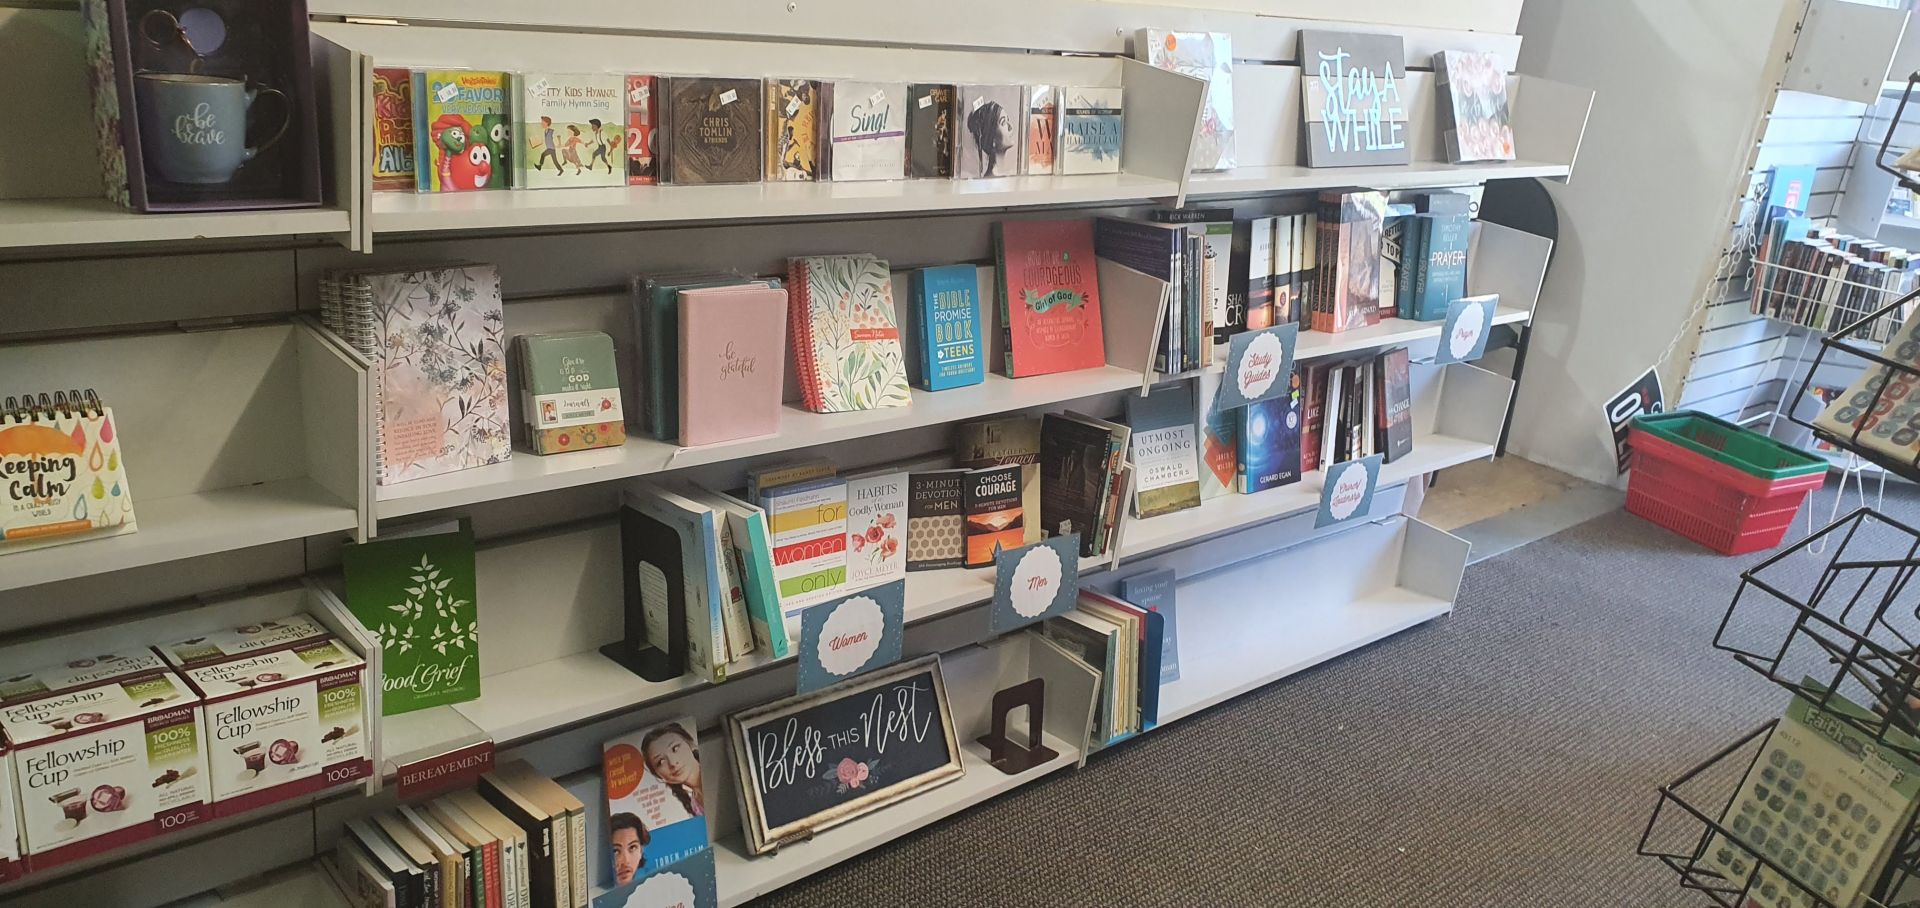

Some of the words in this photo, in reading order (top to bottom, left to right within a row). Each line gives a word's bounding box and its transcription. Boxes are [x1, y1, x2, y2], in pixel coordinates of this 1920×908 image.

[541, 99, 567, 109] Family
[568, 100, 592, 110] Hymn
[593, 101, 610, 110] Sing
[187, 103, 216, 128] be
[703, 117, 729, 127] CHRIS
[171, 114, 225, 145] brave
[700, 128, 732, 137] TOMLIN
[1068, 122, 1106, 136] RAISE
[1112, 122, 1119, 135] A
[1321, 108, 1405, 152] WHILE
[1431, 250, 1464, 267] PRAYER
[1024, 264, 1081, 288] COURAGEOUS
[939, 289, 971, 309] BIBLE
[1048, 294, 1056, 304] of
[1057, 291, 1072, 301] God
[934, 308, 972, 322] PROMISE
[936, 320, 973, 343] BOOK
[719, 341, 736, 360] be
[944, 344, 974, 359] TEENS
[720, 357, 756, 380] grateful
[568, 374, 589, 383] GOD
[1140, 429, 1185, 445] UTMOST
[1138, 440, 1191, 457] ONGOING
[1144, 470, 1190, 483] CHAMBERS
[1149, 463, 1183, 475] OSWALD
[1260, 474, 1278, 483] GERARD
[1279, 471, 1292, 480] EGAN
[9, 474, 71, 500] Calm
[980, 473, 1012, 484] CHOOSE
[857, 484, 898, 500] HABITS
[975, 480, 1017, 497] COURAGE
[817, 504, 842, 524] for
[849, 505, 874, 517] Godly
[874, 501, 904, 512] Woman
[934, 501, 958, 511] MEN
[775, 538, 843, 566] women
[802, 569, 842, 594] only
[1027, 575, 1048, 591] Men
[829, 630, 868, 651] Women
[193, 655, 279, 678] Fellowship
[413, 655, 473, 693] Grief
[199, 672, 235, 683] Cup
[5, 691, 104, 717] Fellowship
[323, 688, 356, 704] 100%
[10, 711, 50, 725] Cup
[216, 696, 300, 727] Fellowship
[152, 727, 191, 745] 100%
[217, 723, 252, 740] Cup
[758, 718, 827, 794] Bless
[827, 728, 860, 750] THIS
[860, 681, 932, 754] Nest
[26, 738, 125, 774] Fellowship
[327, 767, 349, 782] 100
[403, 752, 491, 786] BEREAVEMENT
[28, 769, 69, 788] Cup
[160, 813, 186, 829] 100
